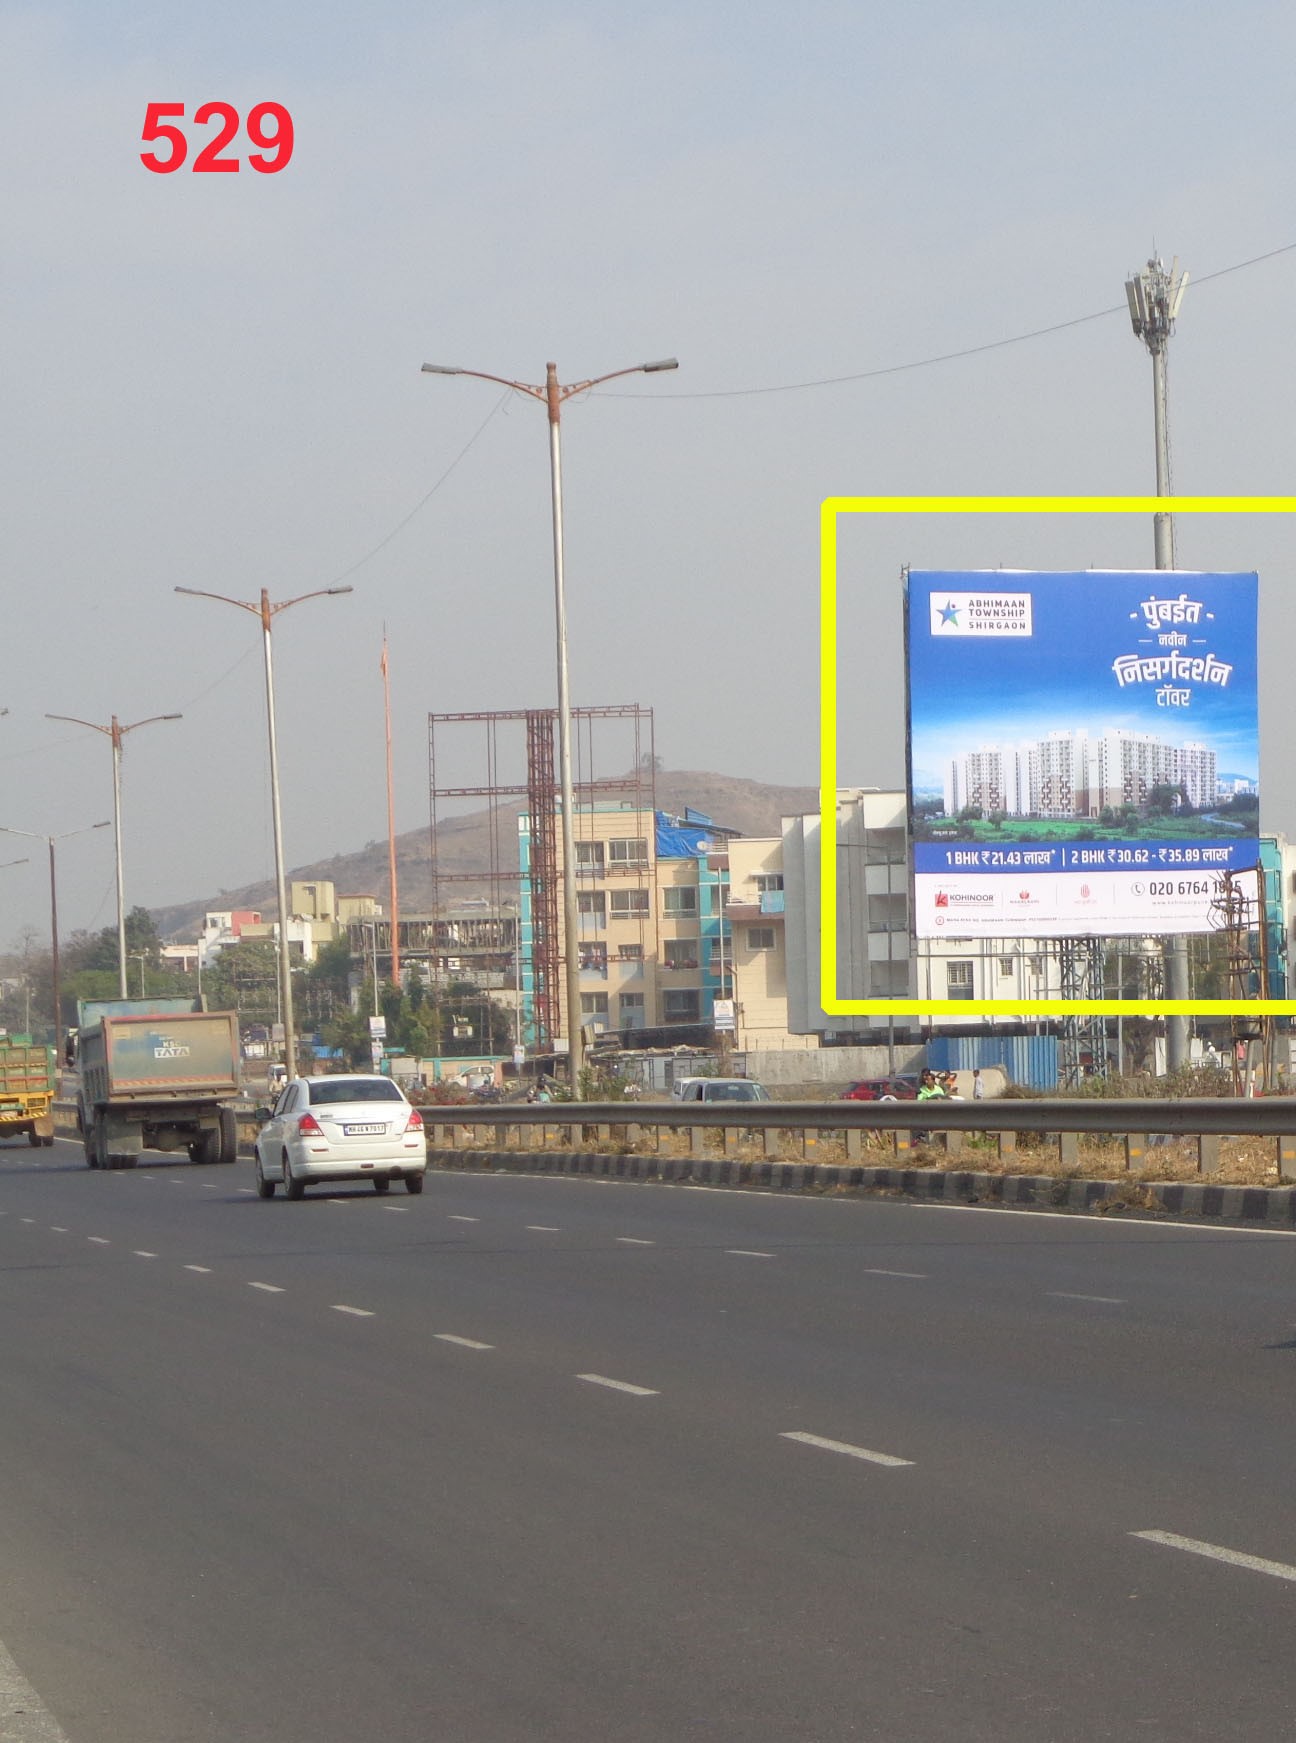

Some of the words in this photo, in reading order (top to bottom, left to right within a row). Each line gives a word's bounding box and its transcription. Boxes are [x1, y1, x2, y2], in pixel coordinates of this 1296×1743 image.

[968, 599, 1025, 608] ABHIMAAN
[968, 608, 1025, 617] TOWNSHIP
[1140, 594, 1203, 630] पुंबईत
[968, 621, 1026, 630] SHIRGAON
[1157, 631, 1187, 646] नवीन
[1111, 650, 1233, 687] निसर्गदर्शन
[1155, 683, 1192, 706] टॉवर
[945, 851, 952, 865] 1
[954, 851, 980, 865] BHK
[1071, 850, 1079, 864] 2
[1081, 850, 1106, 864] BHK
[1150, 881, 1174, 896] 020
[1177, 880, 1209, 895] 6764
[949, 893, 994, 902] KOHINOOR
[155, 1048, 189, 1057] TATA
